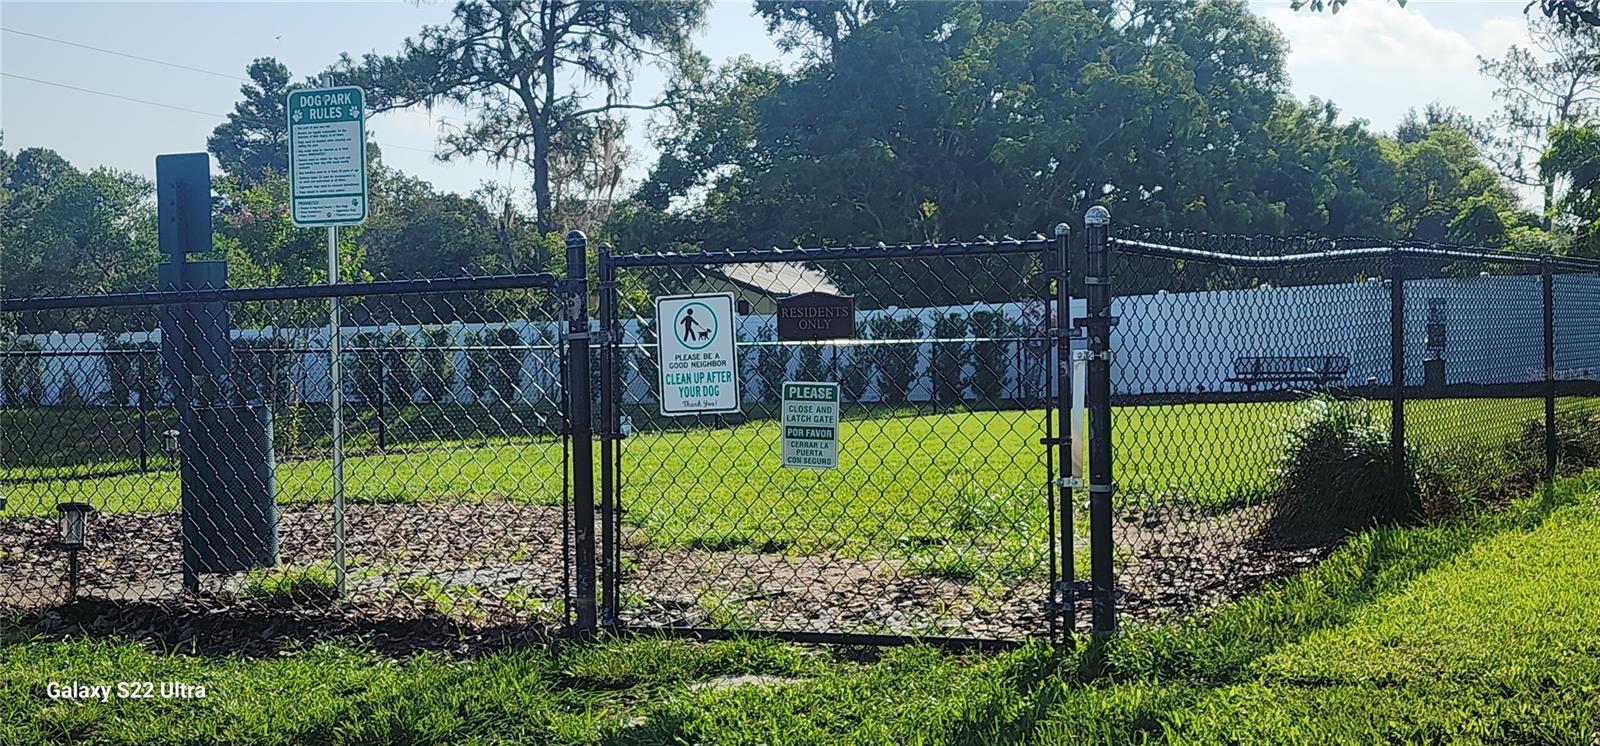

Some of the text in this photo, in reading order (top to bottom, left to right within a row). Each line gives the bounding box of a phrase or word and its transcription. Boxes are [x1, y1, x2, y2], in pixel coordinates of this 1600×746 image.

[300, 93, 352, 107] DOG PARK
[309, 107, 342, 120] RULES
[781, 306, 849, 318] RESIDENTS
[798, 319, 832, 330] ONLY
[674, 353, 701, 361] PLEASE
[669, 360, 727, 369] GOOD NEIGHBOR
[665, 371, 732, 385] CLEAN UP AFTER
[678, 385, 720, 398] YOUR DOG
[789, 386, 833, 399] PLEASE
[682, 400, 718, 408] Thank You!
[788, 405, 832, 414] CLOSE AND
[786, 414, 834, 423] LATCH GATE
[787, 428, 832, 438] POR FAVOR
[787, 456, 832, 465] CON SEGURO
